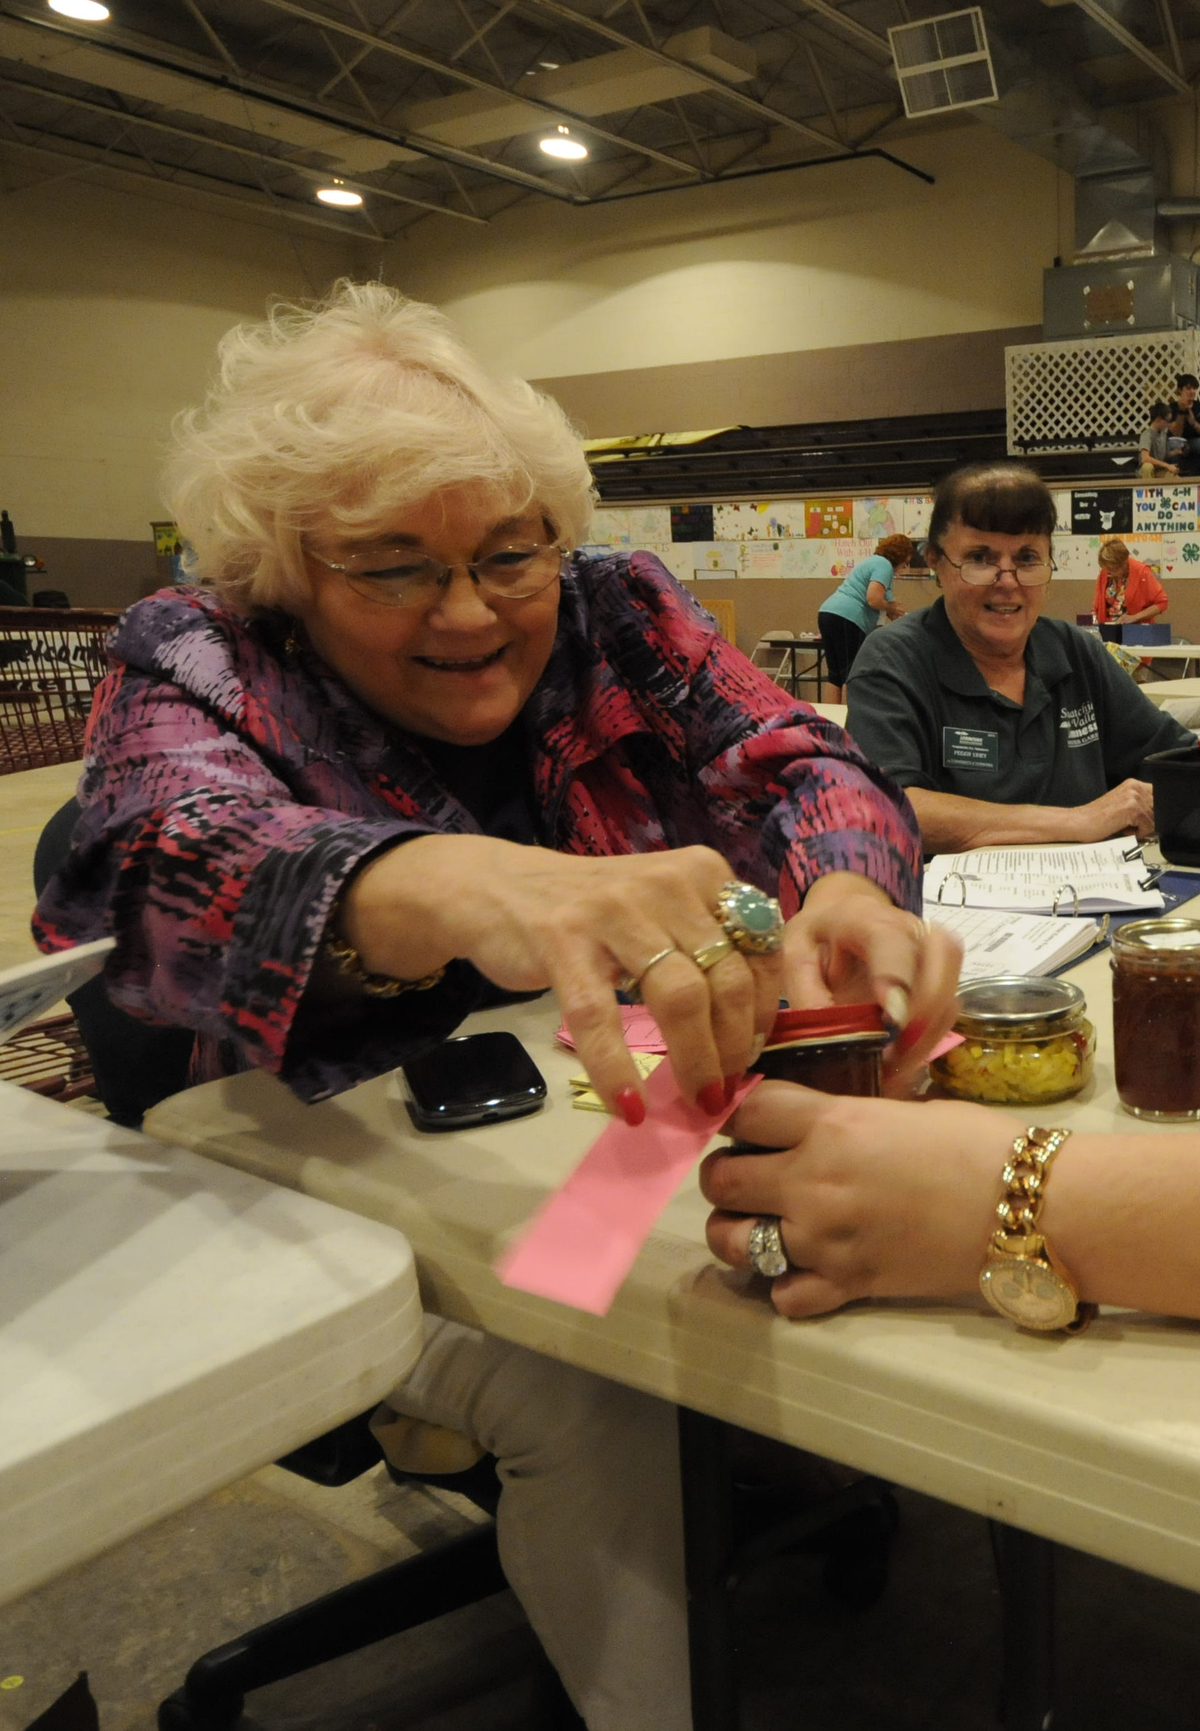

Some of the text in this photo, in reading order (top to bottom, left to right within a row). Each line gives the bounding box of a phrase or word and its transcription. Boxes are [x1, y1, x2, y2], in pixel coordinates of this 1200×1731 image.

[1135, 487, 1191, 499] WITH 4-H
[1136, 501, 1196, 512] YOU CAN
[1158, 511, 1173, 520] DO
[1136, 522, 1195, 532] ANYTHING
[835, 539, 873, 547] Hatch Out
[837, 548, 871, 557] With 4-H
